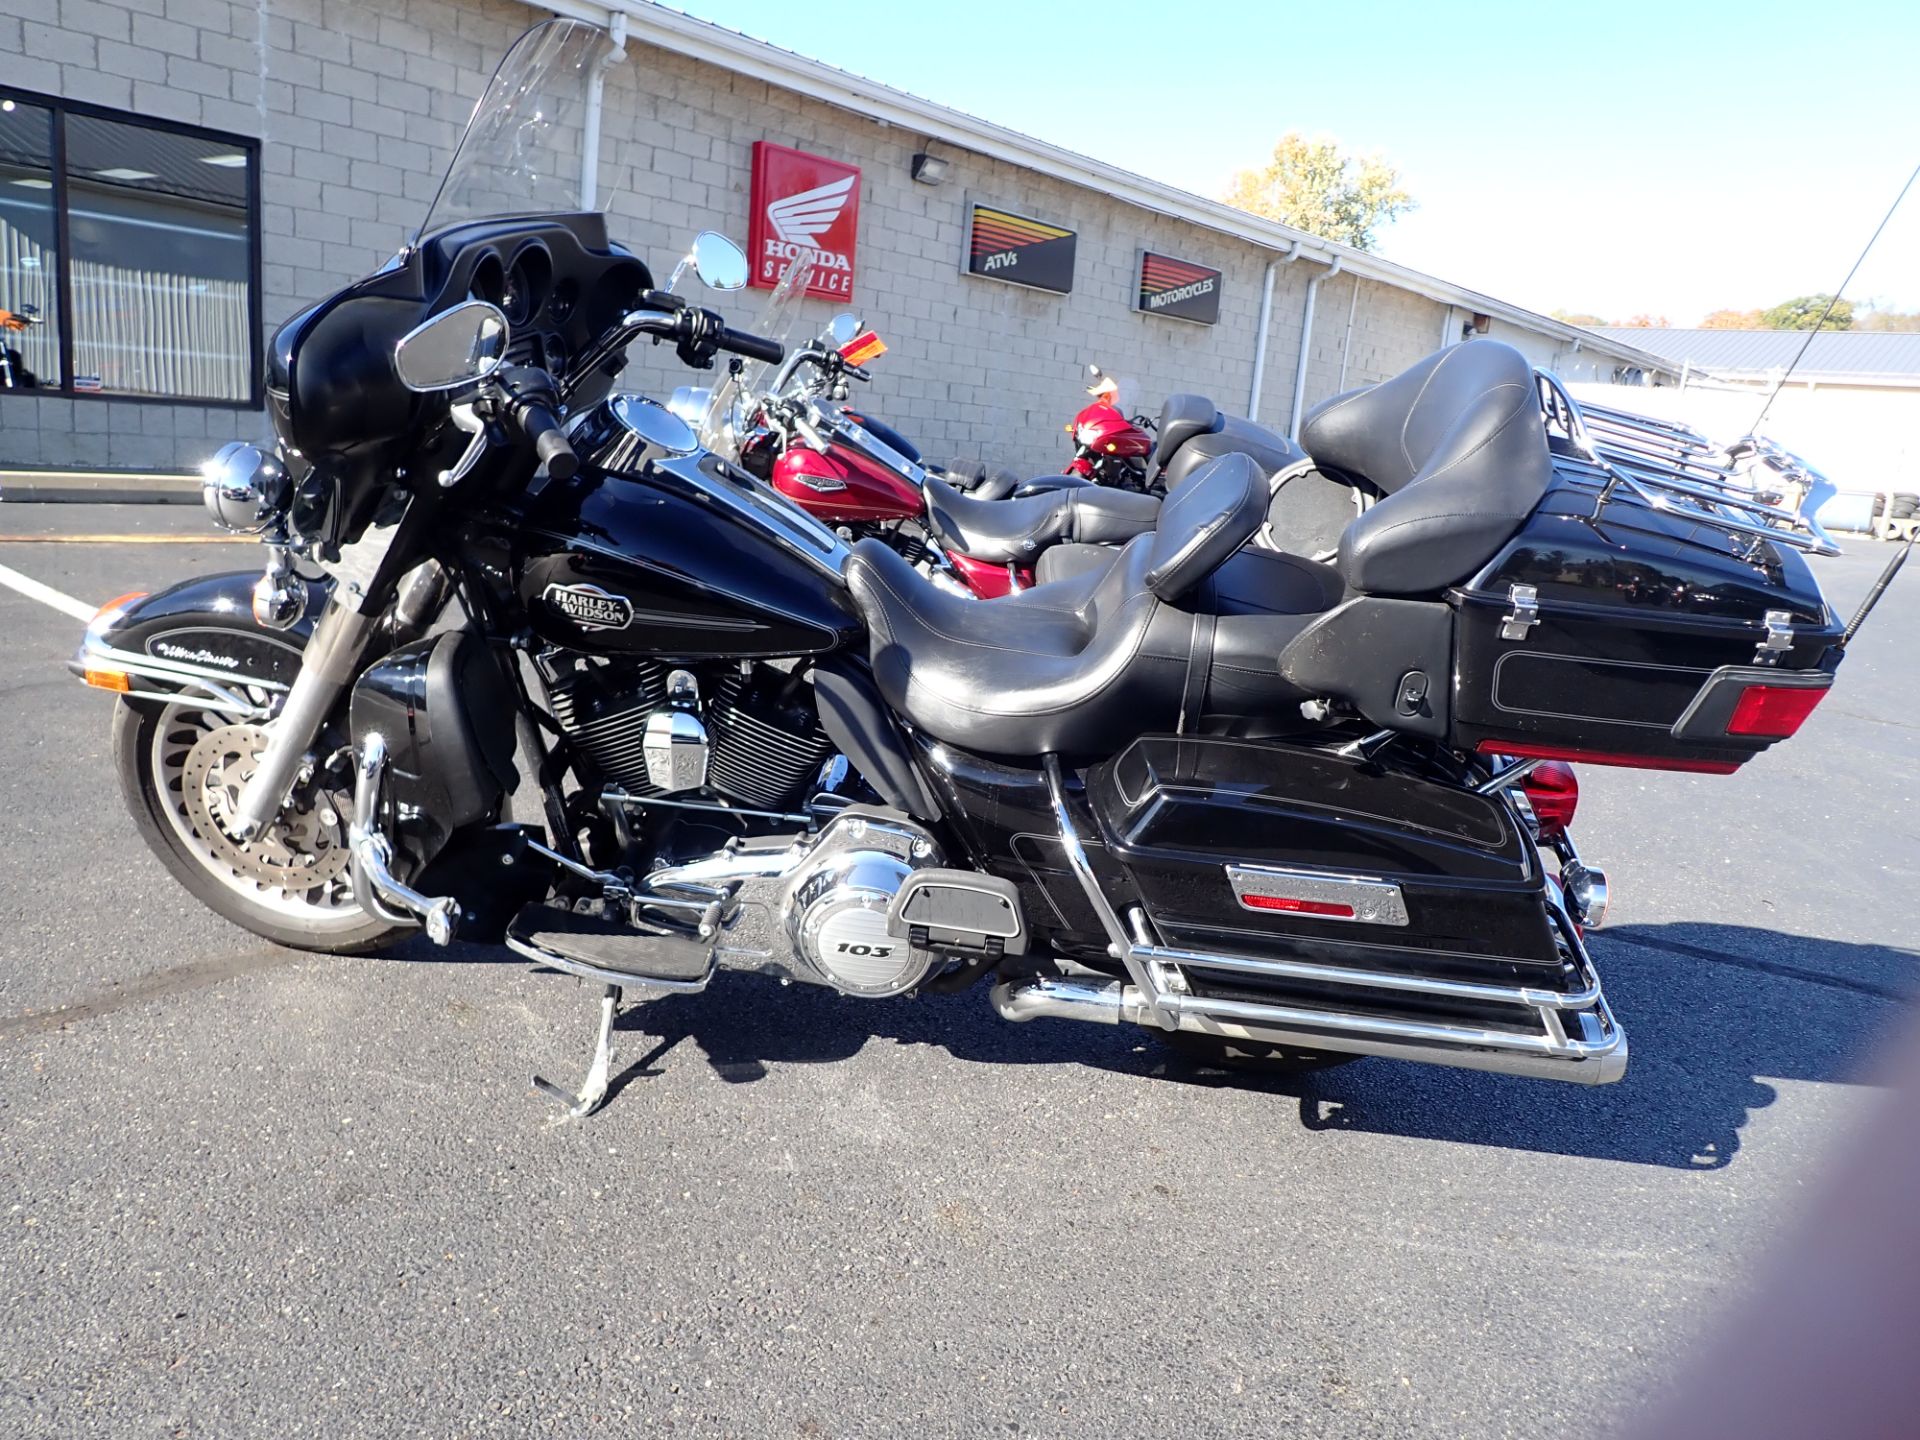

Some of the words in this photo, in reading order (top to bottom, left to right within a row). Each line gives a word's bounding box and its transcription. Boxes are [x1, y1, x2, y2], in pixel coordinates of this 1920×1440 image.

[764, 239, 852, 271] HONDA
[984, 251, 1018, 271] ATVs
[763, 260, 851, 292] SEVICE
[1150, 278, 1214, 309] MOTORCYCLES
[551, 600, 624, 622] AVIDSON
[837, 942, 893, 957] 103
